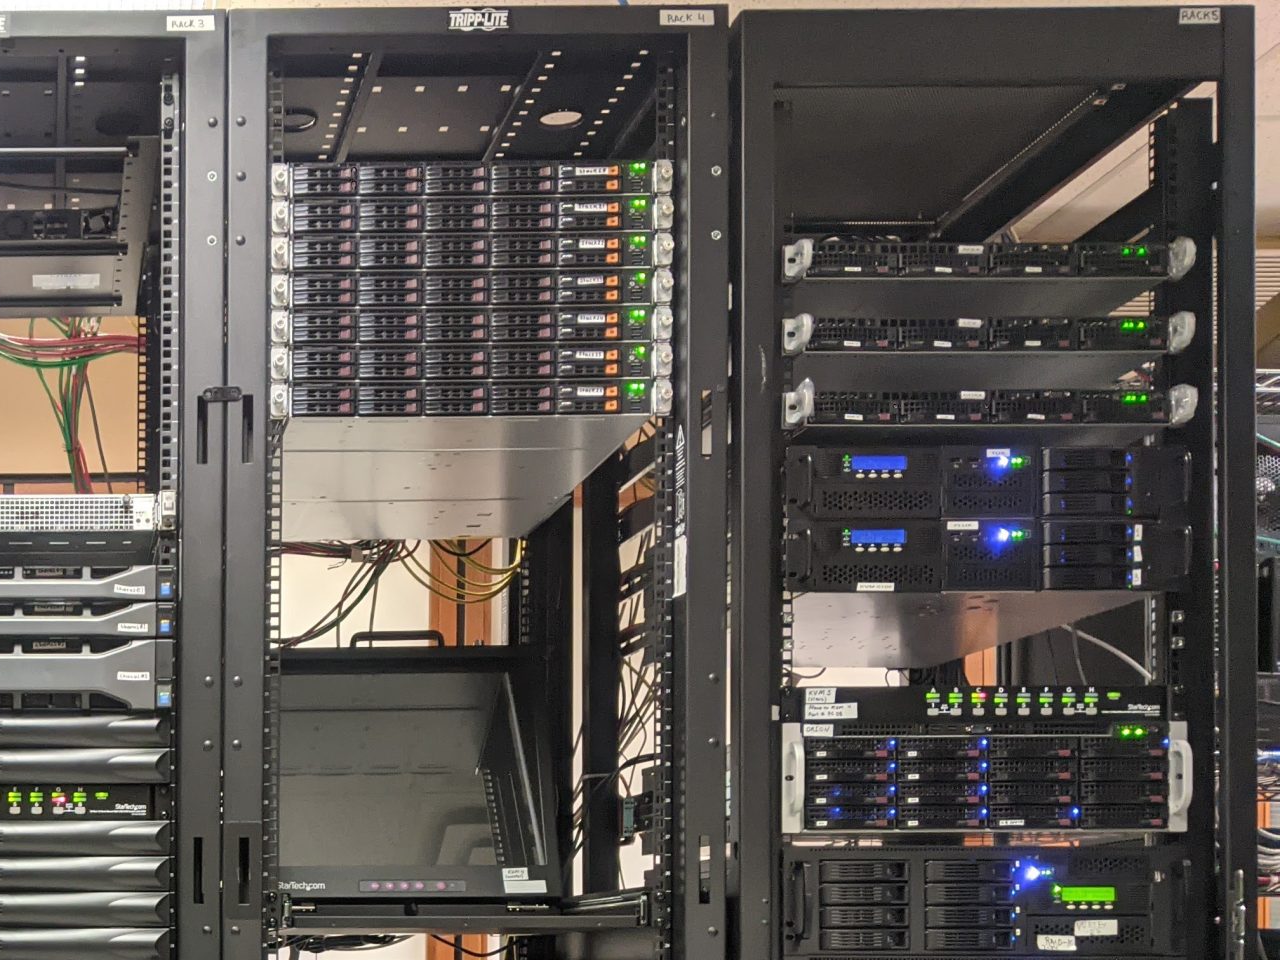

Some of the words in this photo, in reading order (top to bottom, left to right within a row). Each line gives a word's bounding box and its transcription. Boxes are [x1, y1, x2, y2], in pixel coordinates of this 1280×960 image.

[667, 14, 692, 24] RACK
[697, 12, 705, 23] 4
[171, 20, 196, 29] RACK
[198, 19, 205, 28] 3
